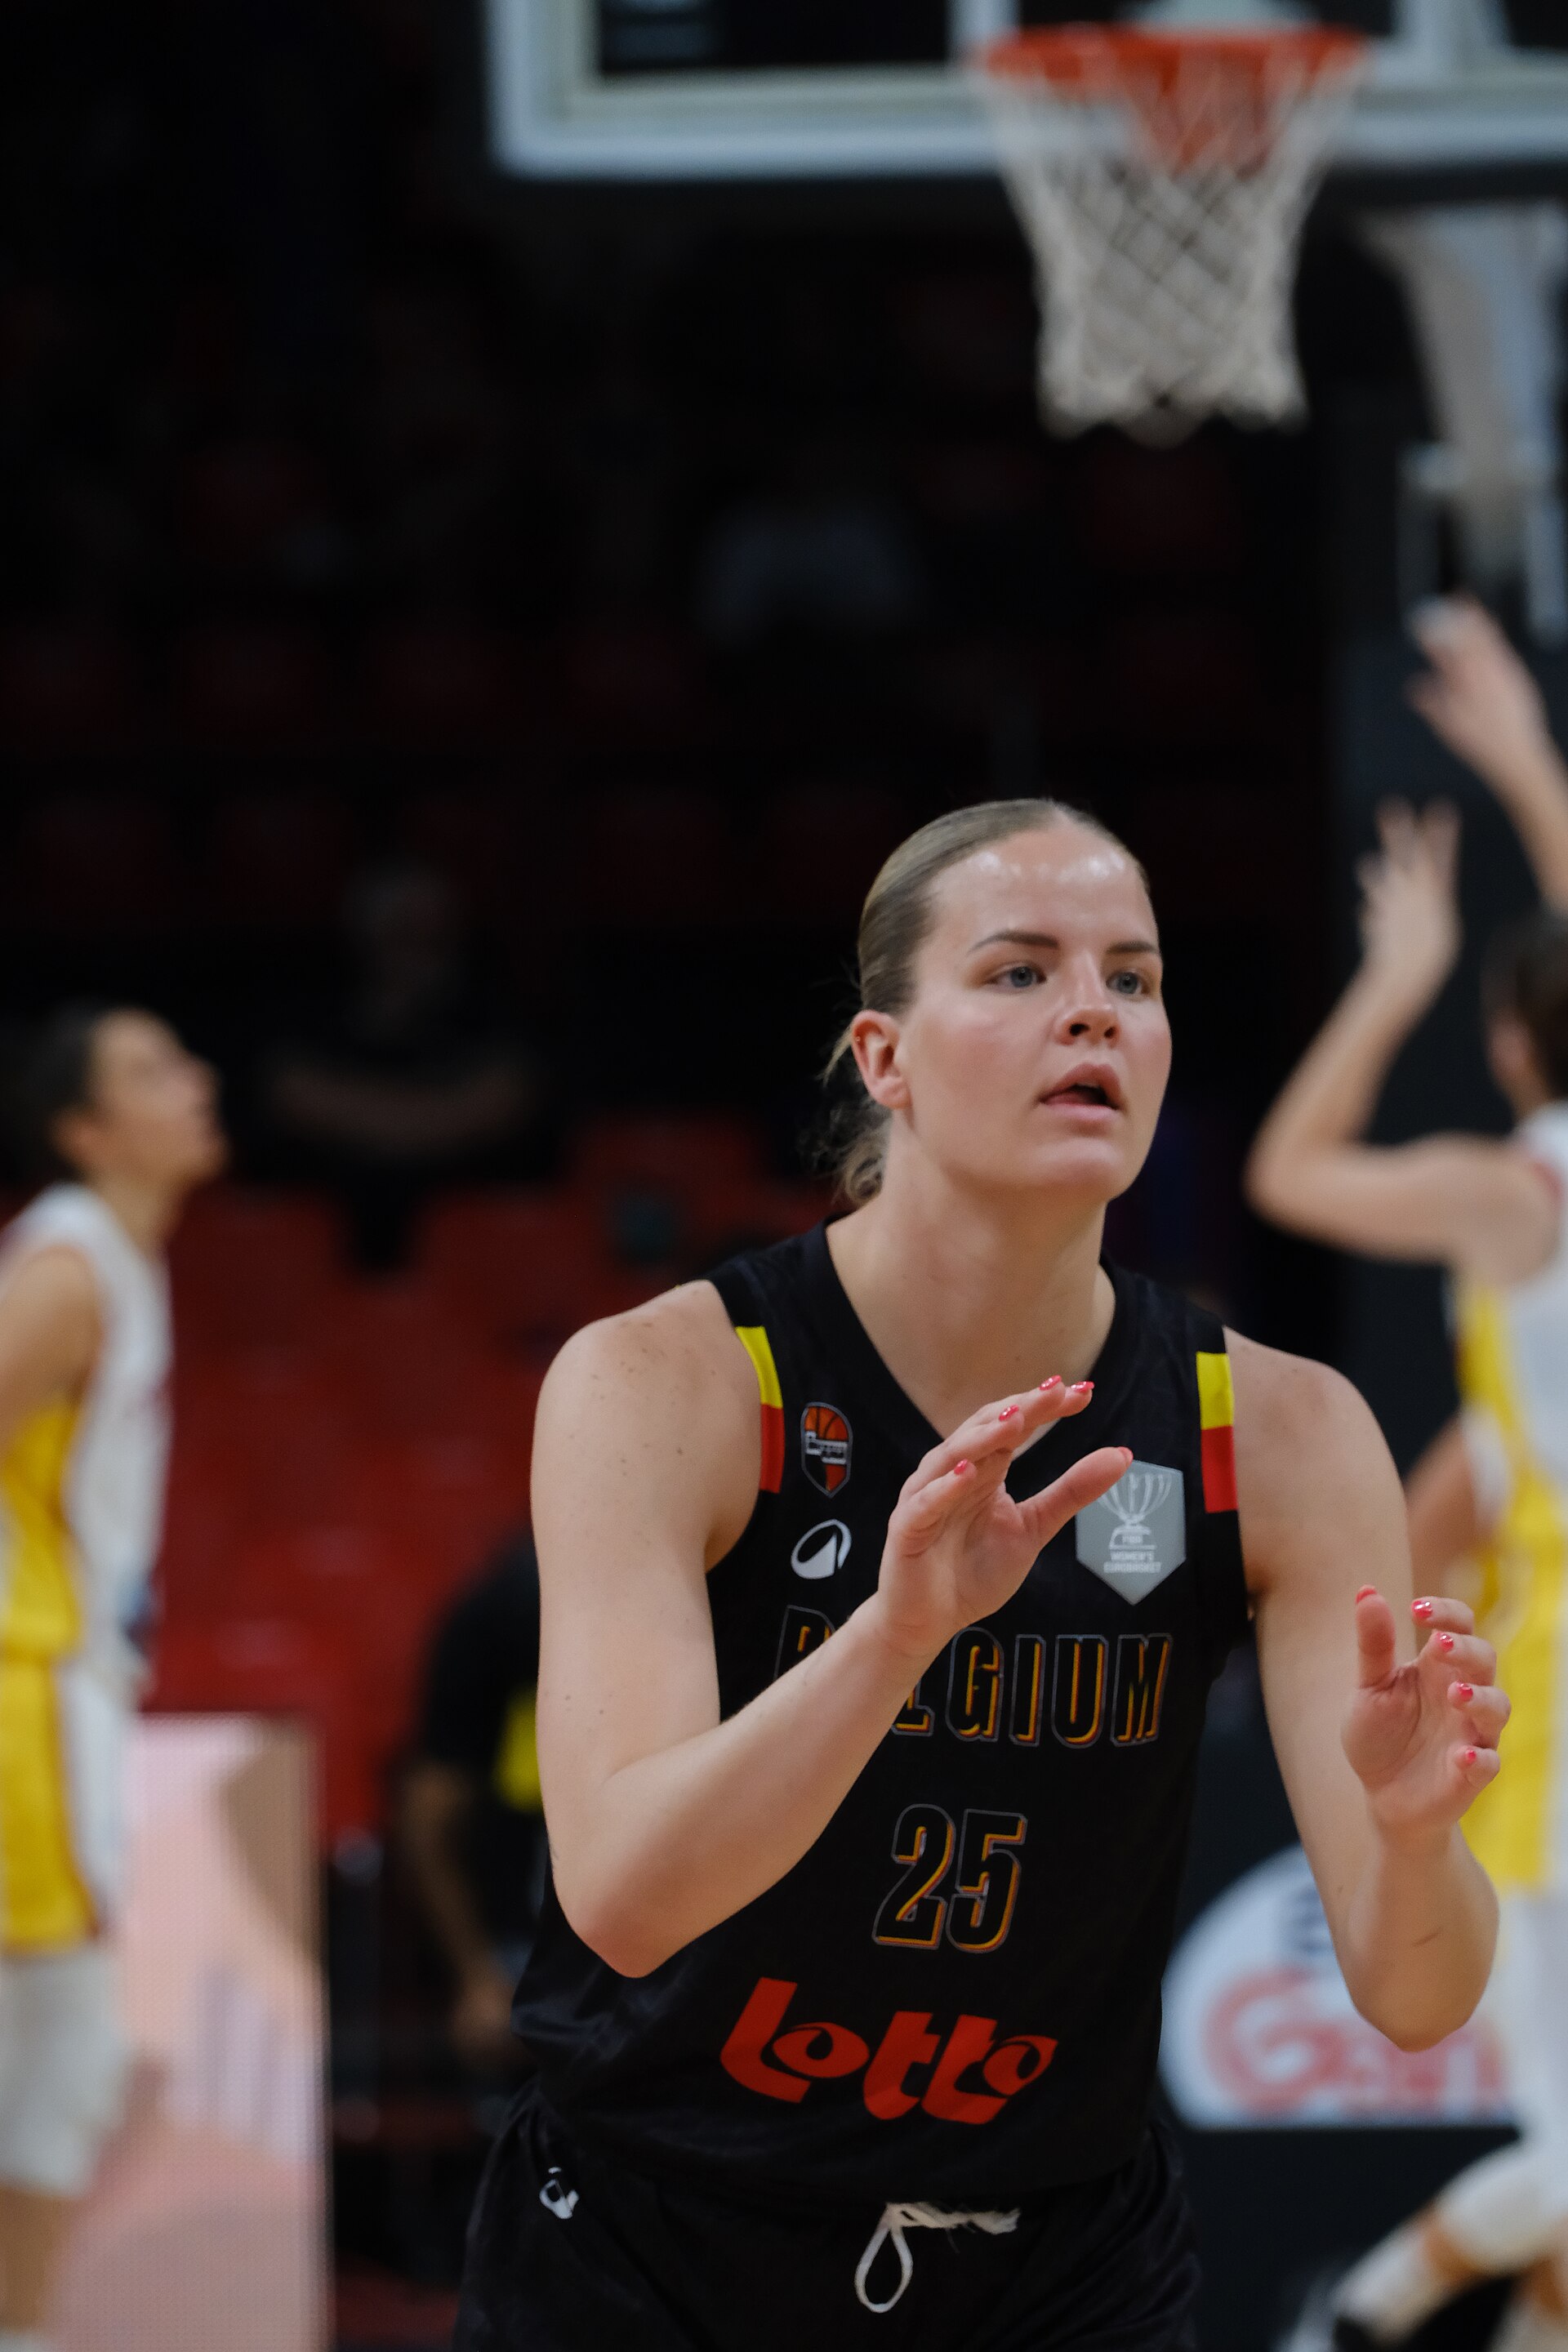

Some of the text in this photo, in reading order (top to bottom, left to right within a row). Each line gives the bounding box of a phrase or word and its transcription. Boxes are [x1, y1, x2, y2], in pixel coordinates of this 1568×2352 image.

[774, 1604, 1173, 1748] LGIUM
[871, 1803, 1028, 1953] 25
[719, 1976, 1059, 2125] Lotto
